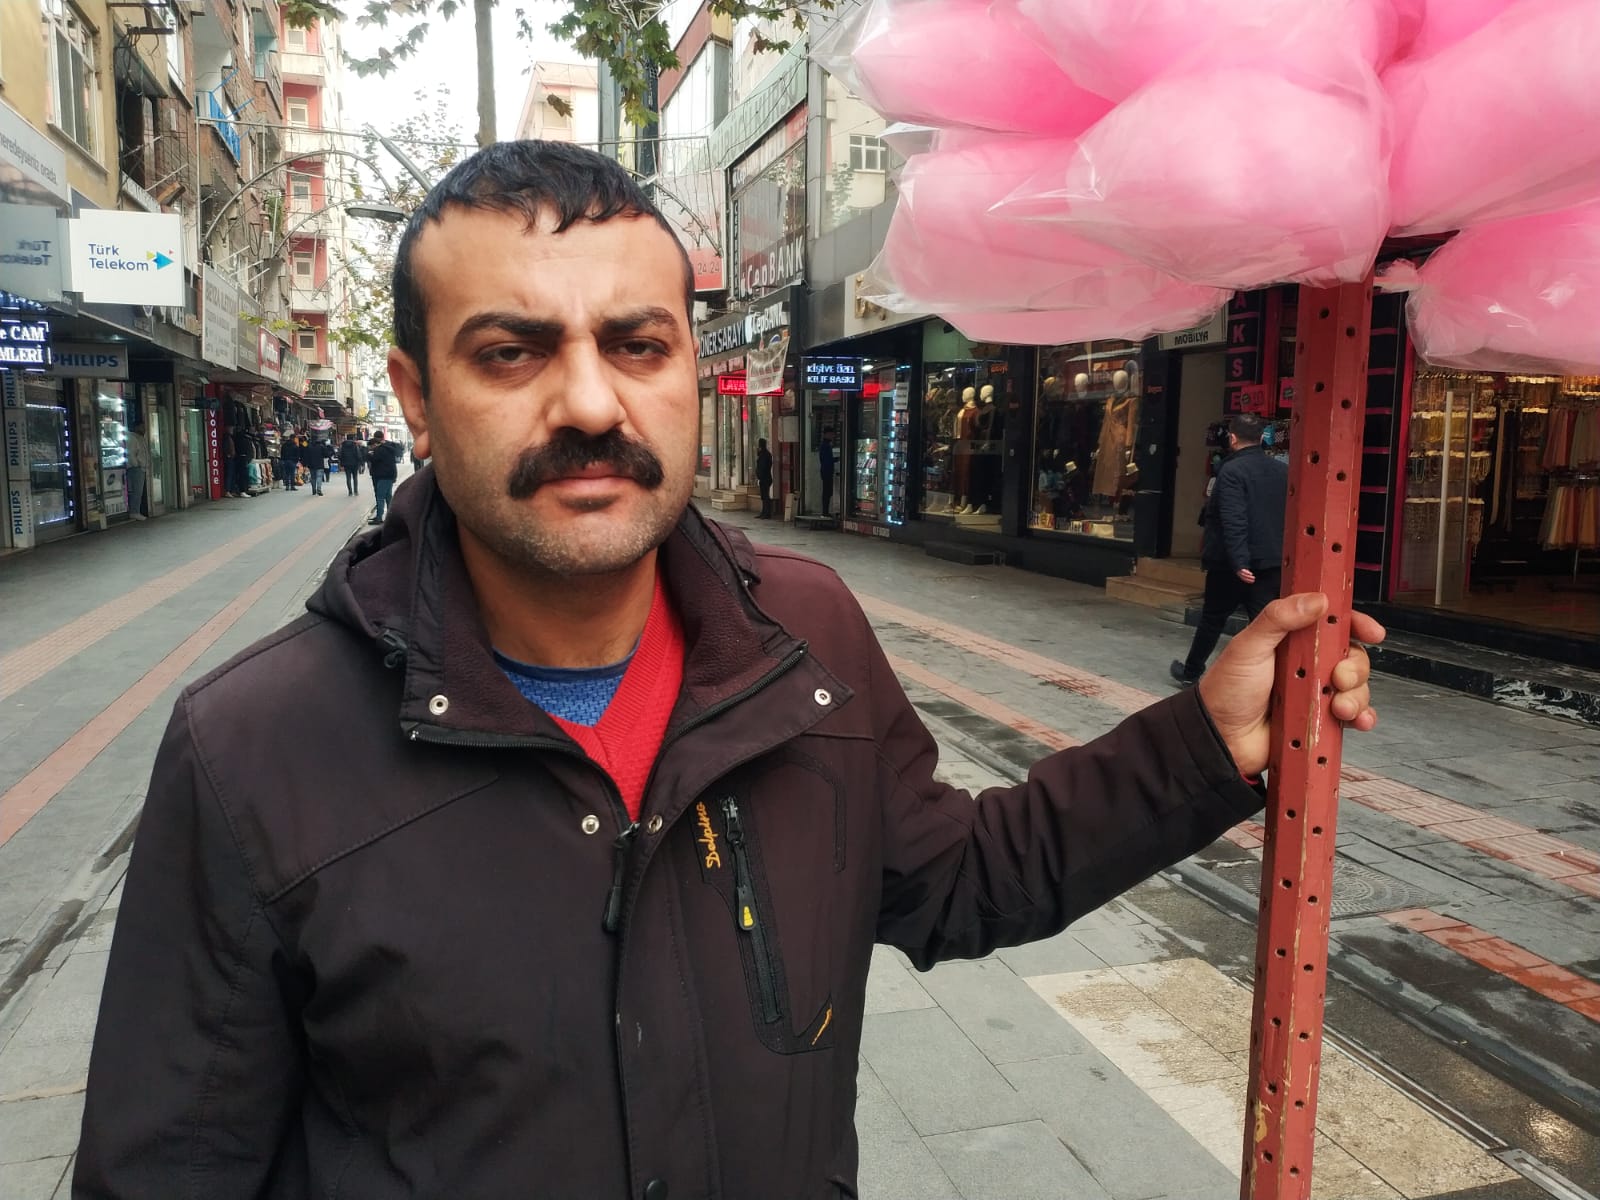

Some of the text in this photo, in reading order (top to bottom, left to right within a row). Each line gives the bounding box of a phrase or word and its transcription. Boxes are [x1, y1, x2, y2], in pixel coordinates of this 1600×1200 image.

[88, 243, 120, 256] Türk
[89, 257, 149, 271] Telekom
[10, 325, 46, 342] CAM
[8, 421, 19, 467] PHILIPS
[209, 409, 220, 485] vodafone
[11, 490, 24, 535] PHILIPS
